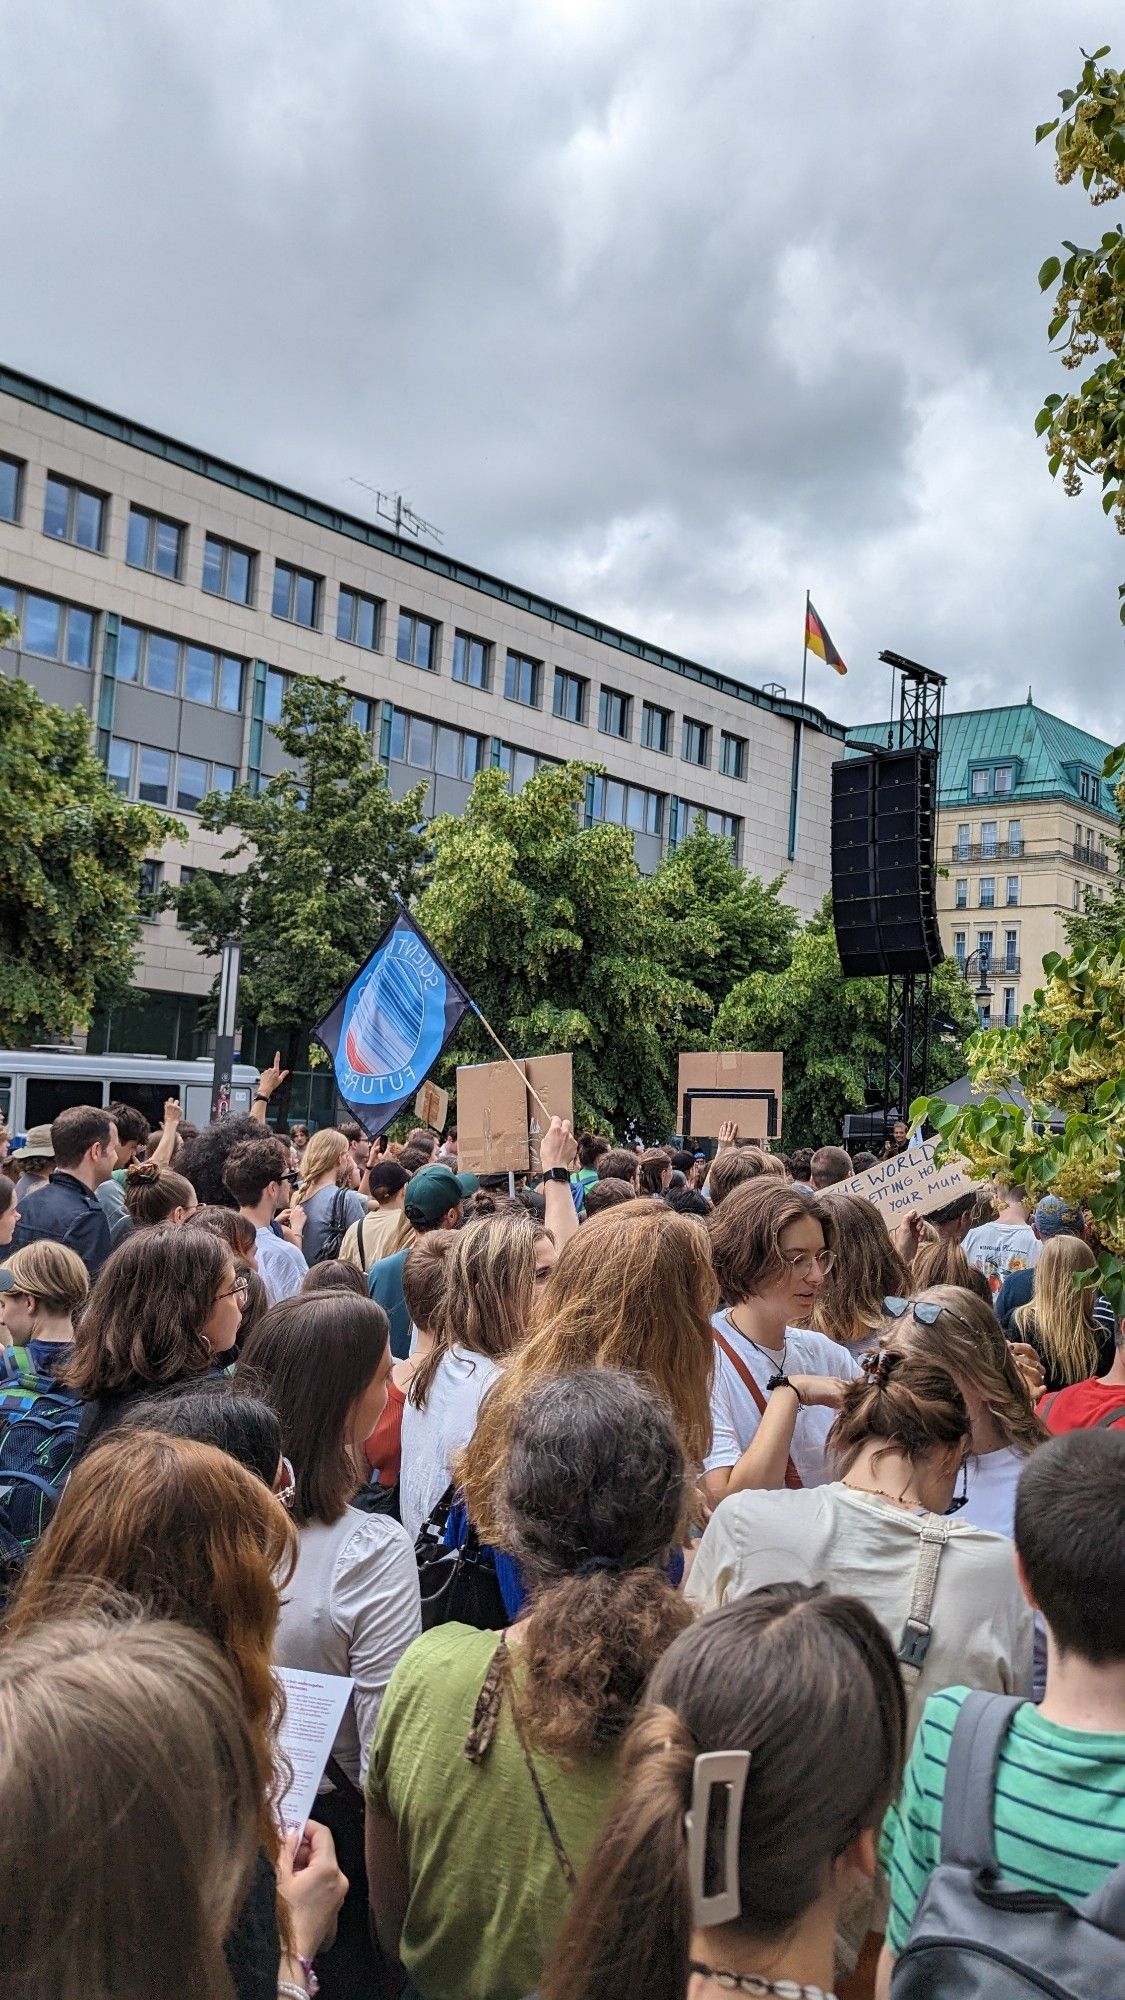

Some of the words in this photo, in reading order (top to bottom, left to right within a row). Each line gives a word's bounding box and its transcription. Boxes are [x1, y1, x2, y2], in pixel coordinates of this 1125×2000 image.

[867, 1143, 936, 1186] WORLD
[868, 1176, 913, 1205] ETTING
[889, 1191, 922, 1212] YOUR
[928, 1174, 961, 1194] MUM
